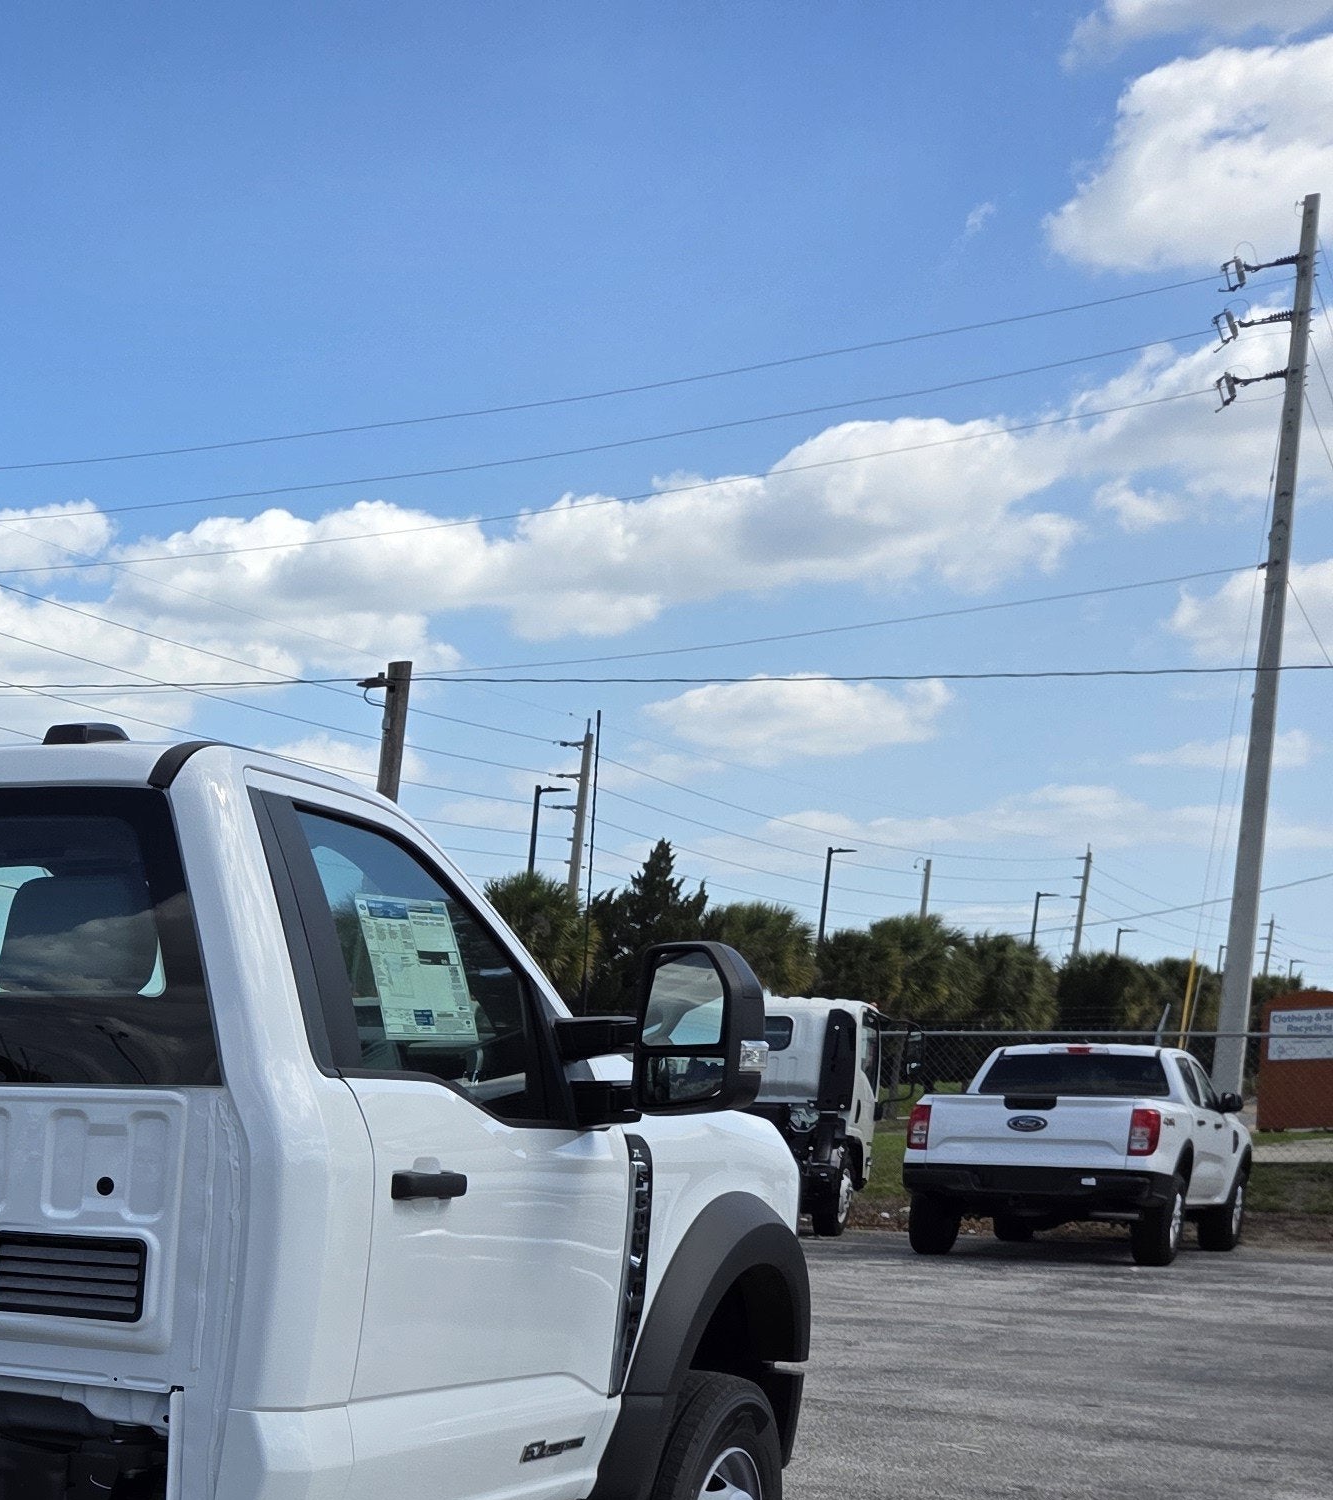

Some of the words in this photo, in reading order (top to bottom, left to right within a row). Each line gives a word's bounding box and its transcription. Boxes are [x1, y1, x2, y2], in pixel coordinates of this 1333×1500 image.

[1272, 1014, 1314, 1024] Clothing
[1314, 1012, 1323, 1022] &
[1286, 1024, 1333, 1033] Recycling
